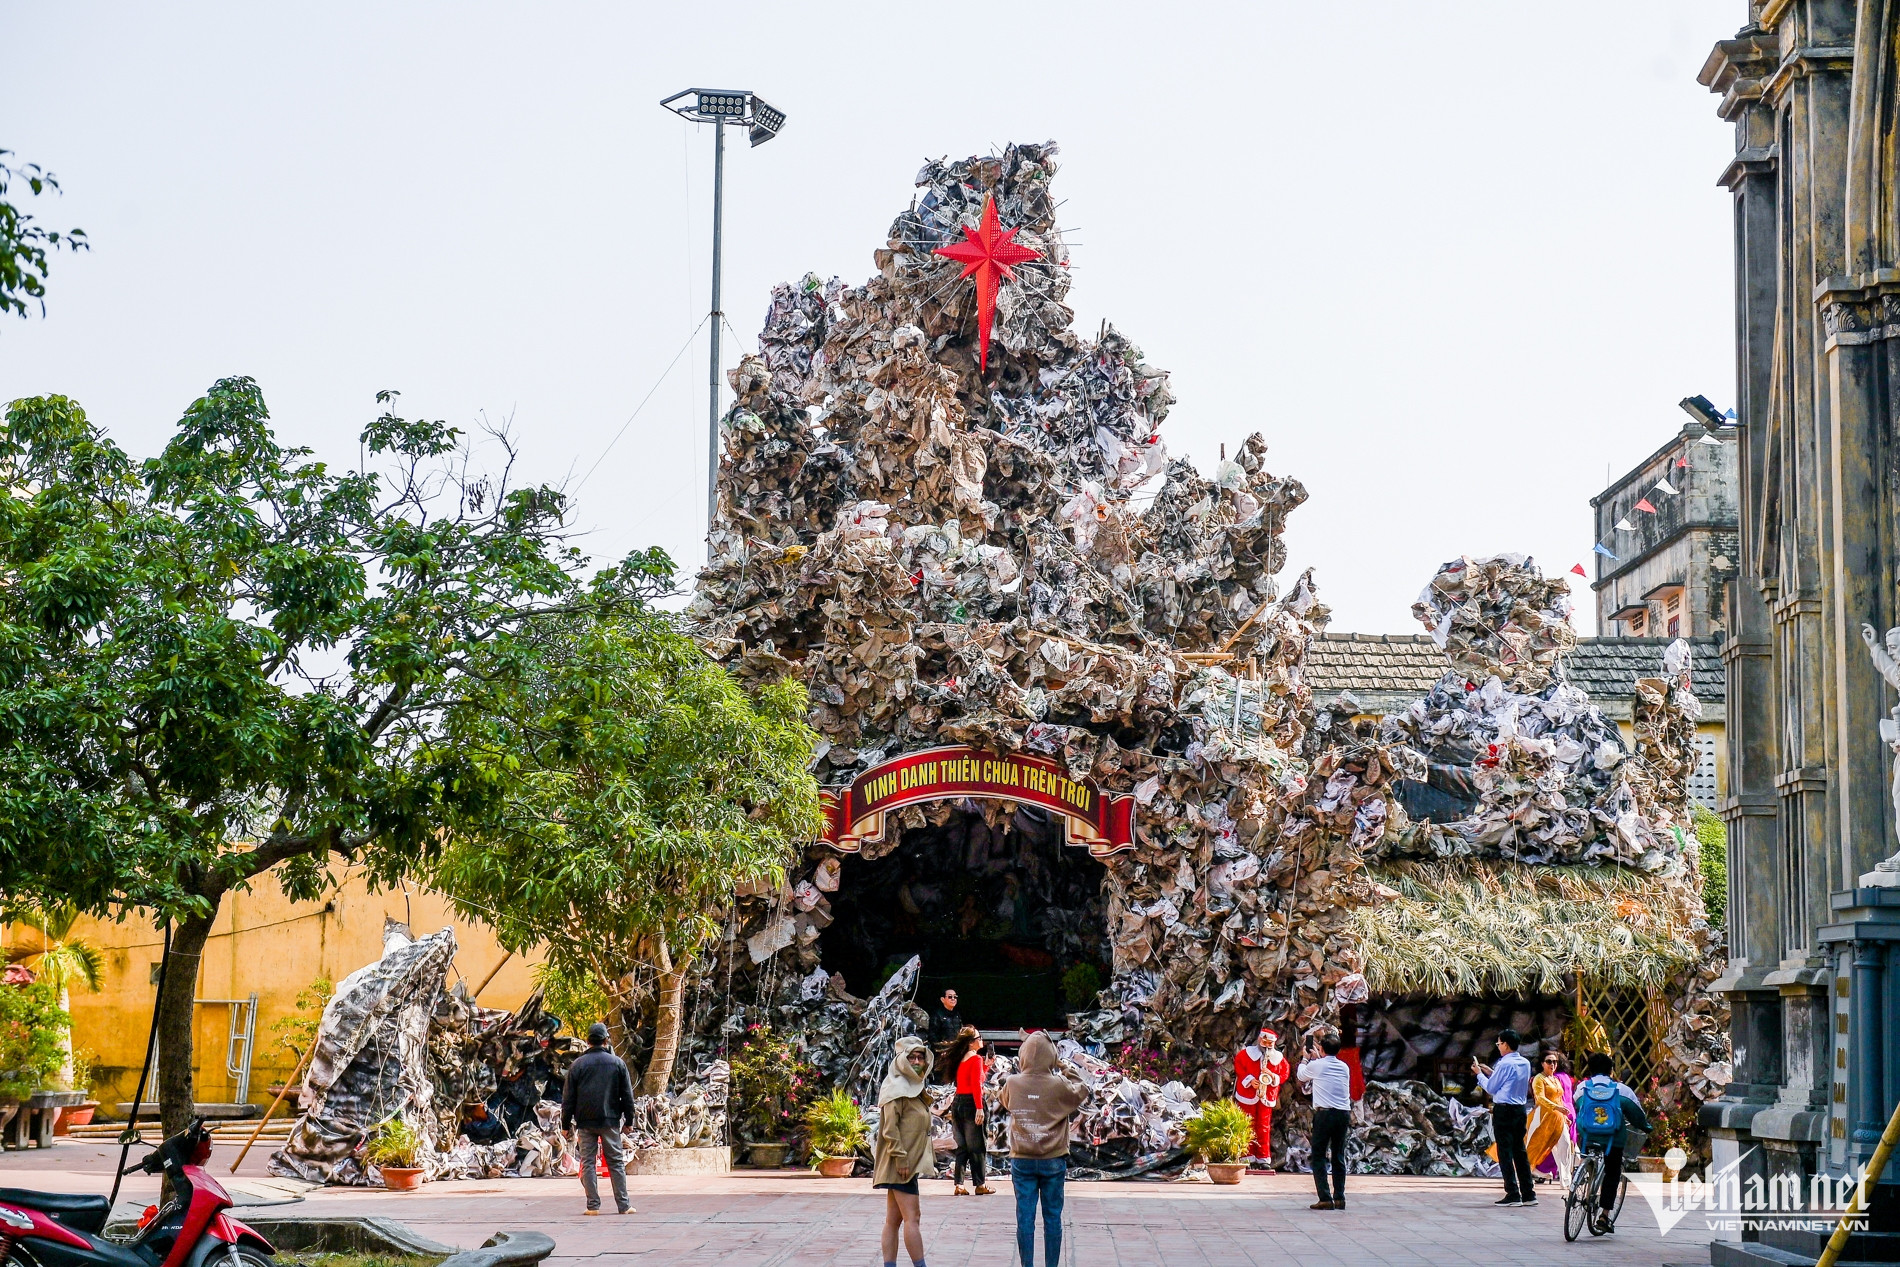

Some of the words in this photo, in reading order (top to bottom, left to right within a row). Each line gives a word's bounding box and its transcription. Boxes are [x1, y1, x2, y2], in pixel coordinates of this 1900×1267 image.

[863, 773, 897, 805] VINH
[900, 763, 937, 790] DANH
[940, 755, 980, 782] THIÊN
[983, 757, 1019, 785] CHÚA
[1022, 765, 1057, 797] TRÊN
[1060, 777, 1091, 812] TRỜI
